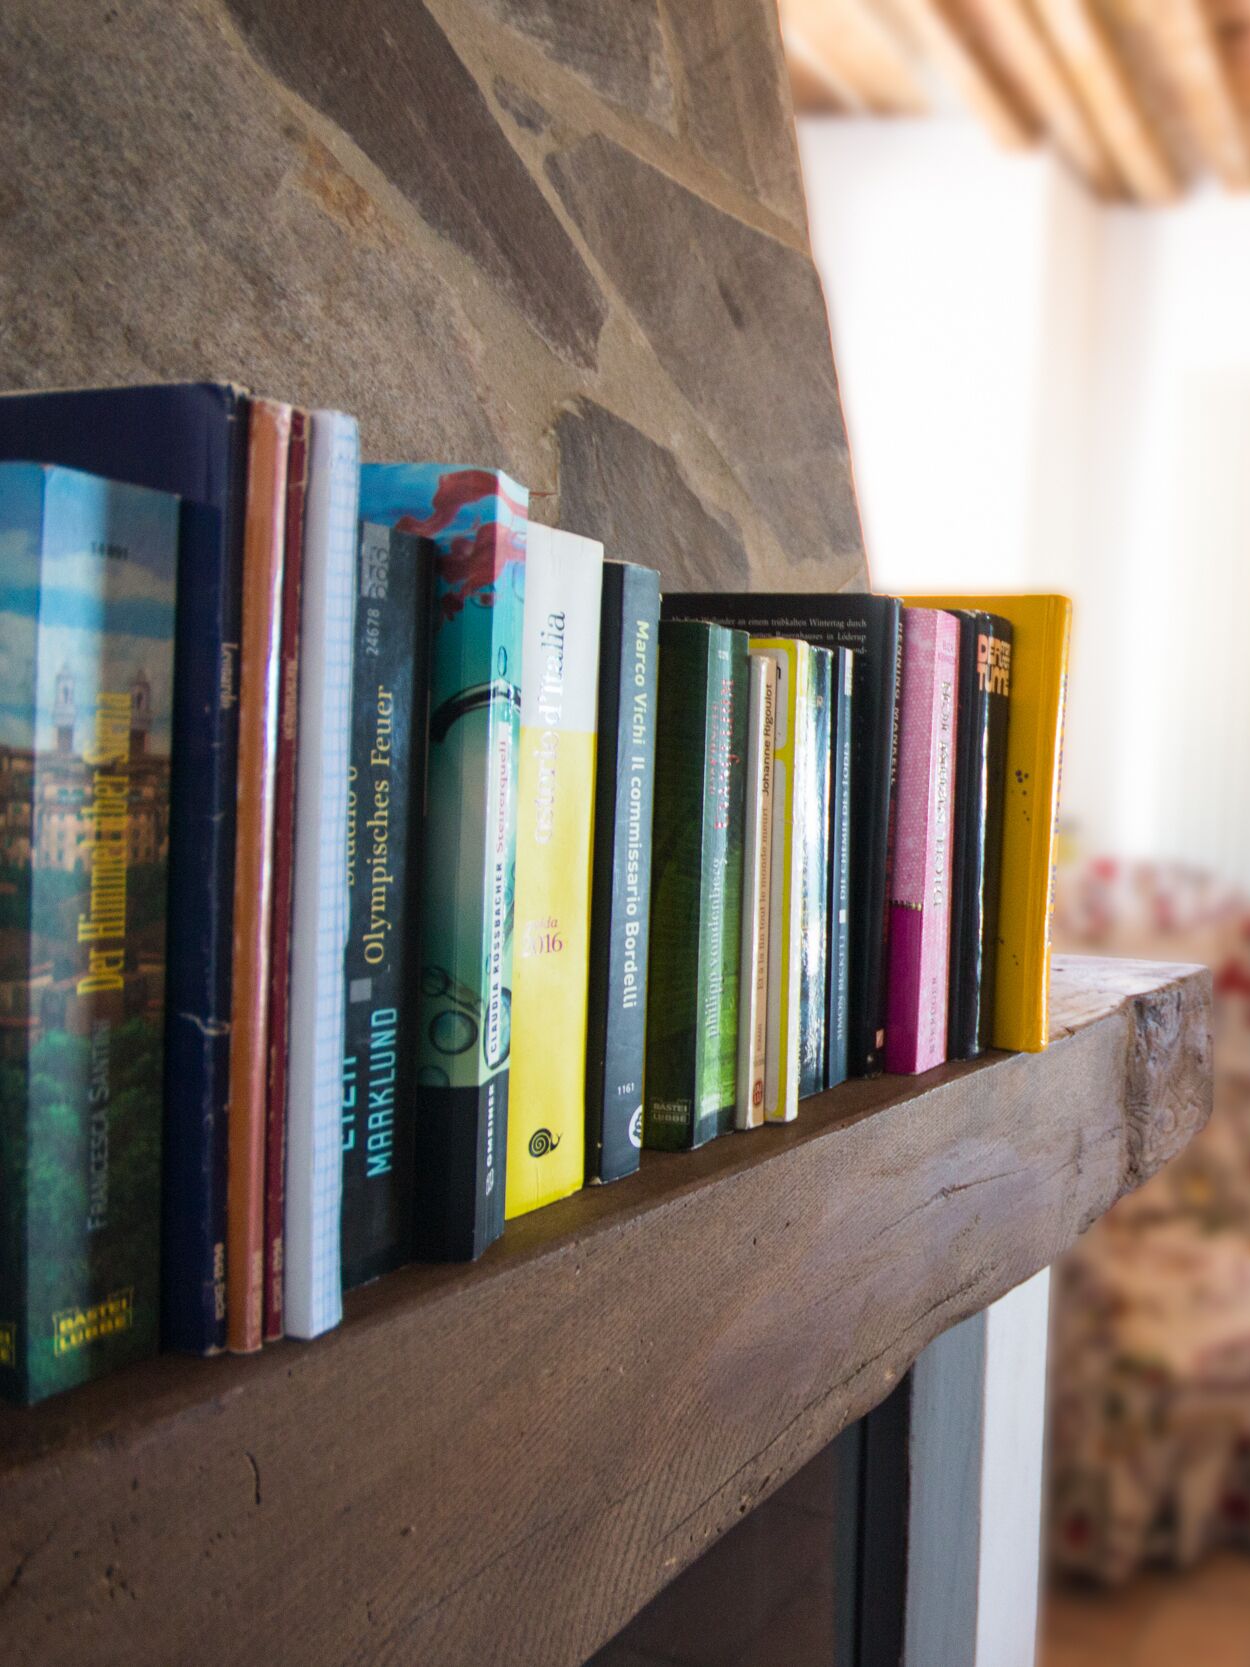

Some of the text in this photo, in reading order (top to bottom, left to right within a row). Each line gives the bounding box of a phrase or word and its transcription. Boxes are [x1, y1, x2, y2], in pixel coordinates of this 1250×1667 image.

[365, 608, 380, 656] 24678
[634, 621, 650, 687] Marco
[809, 617, 845, 629] Wintertag
[847, 617, 867, 627] durch
[632, 693, 648, 745] Vichi
[763, 684, 774, 737] Rigoulot
[890, 622, 904, 785] HENNING MANKELL
[762, 740, 771, 797] Johanne
[363, 684, 395, 965] Olympisches Feuer
[625, 776, 642, 912] commissario
[840, 822, 848, 874] CHEMIE
[77, 840, 127, 943] Himmel
[489, 739, 509, 1053] CLAUDIA ROSSBACHER Steirerquell
[77, 949, 125, 997] Der
[622, 922, 640, 1009] Bordelli
[704, 973, 725, 1038] philipp
[365, 1008, 397, 1181] MARKLUND
[617, 1081, 636, 1096] 1161
[485, 1084, 497, 1169] GMEINER
